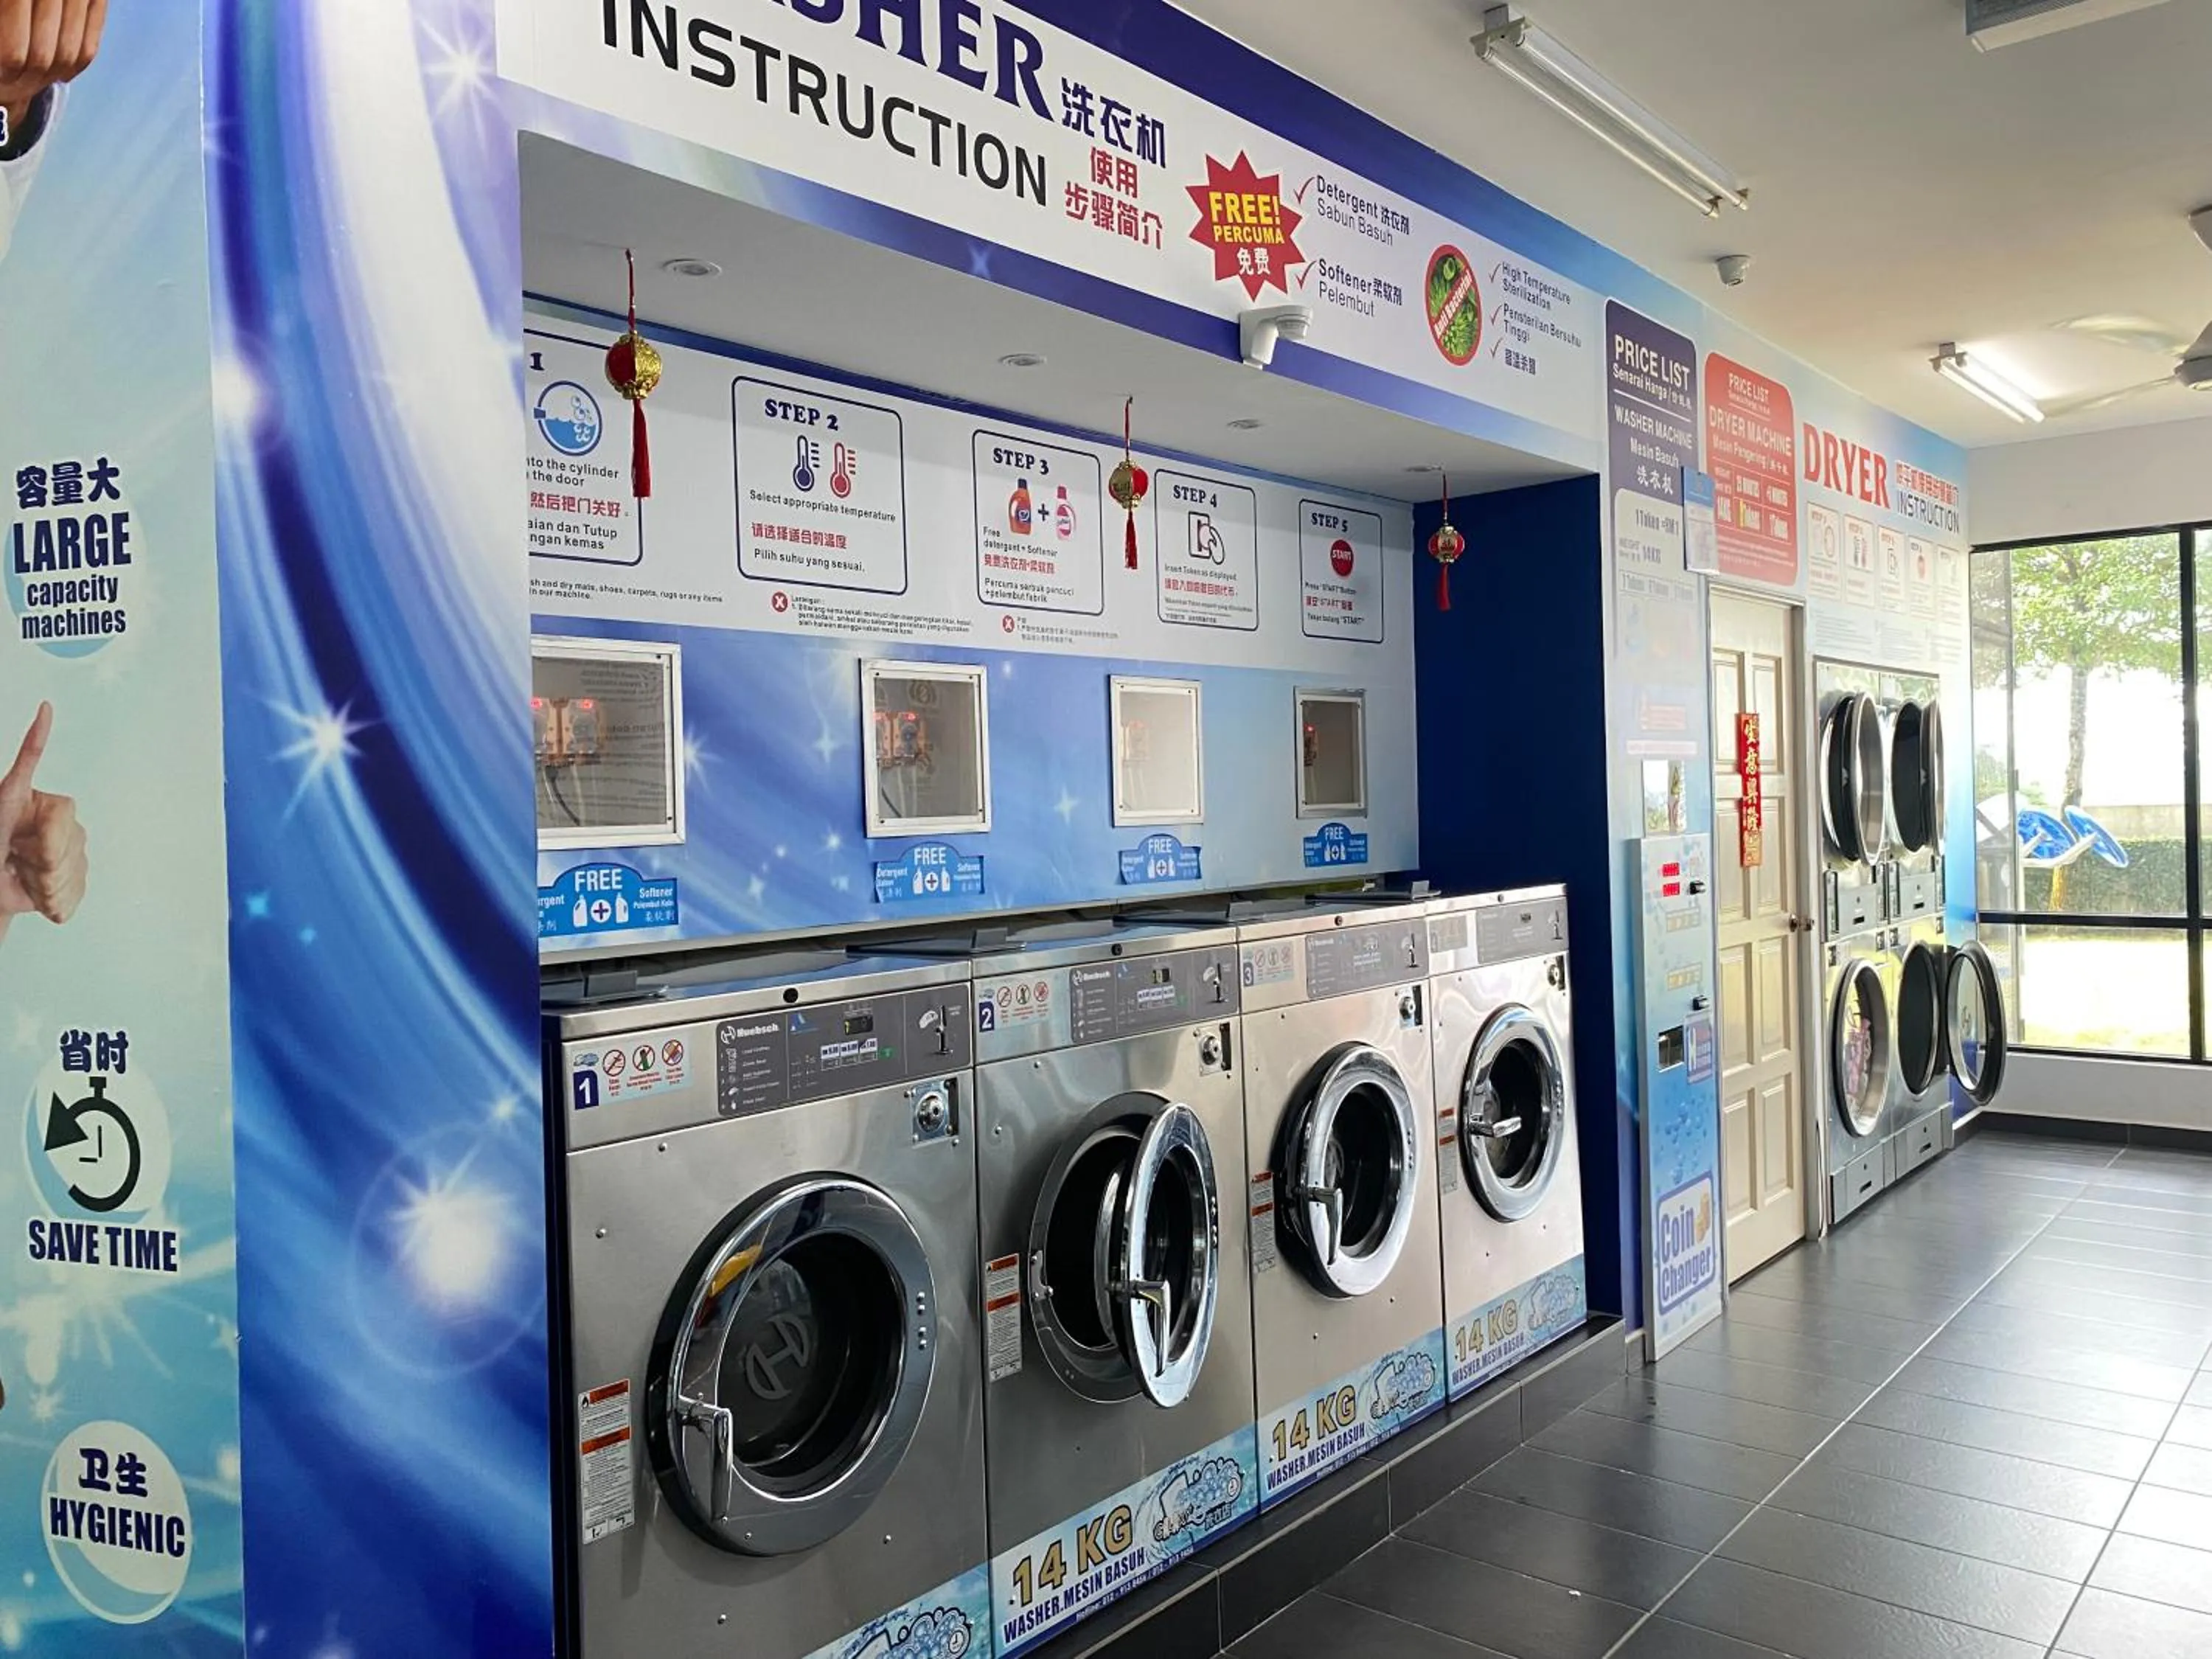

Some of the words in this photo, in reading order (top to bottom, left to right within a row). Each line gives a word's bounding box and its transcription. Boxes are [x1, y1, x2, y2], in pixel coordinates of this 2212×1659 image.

[599, 0, 1046, 206] INSTRUCTION
[1062, 77, 1166, 168] 洗衣机
[1090, 147, 1138, 199] 使用
[1209, 191, 1281, 224] FREE!
[1317, 175, 1378, 218] Detergent
[1065, 180, 1162, 250] 步骤简介
[1318, 198, 1354, 231] Sabun
[1358, 217, 1393, 246] Basuh
[1212, 225, 1284, 245] PERCUMA
[1237, 247, 1270, 276] 免费
[1319, 259, 1372, 293] Softener
[1320, 281, 1374, 317] Pelembut
[1503, 262, 1521, 281] High
[1523, 271, 1571, 305] Temperature
[1504, 319, 1530, 343] Tinggi
[529, 352, 544, 371] 1
[1613, 363, 1644, 389] Senarai
[1614, 334, 1659, 378] PRICE
[1661, 355, 1690, 391] LIST
[1728, 372, 1752, 398] PRICE
[1753, 381, 1770, 403] LIST
[765, 398, 820, 425] STEP
[827, 414, 838, 431] 2
[1614, 403, 1654, 437] WASHER
[1655, 419, 1692, 450] MACHINE
[1708, 406, 1746, 437] DRYER
[1747, 420, 1792, 456] MACHINE
[547, 459, 566, 471] the
[569, 464, 619, 479] cylinder
[993, 448, 1034, 470] STEP
[1039, 459, 1049, 475] 3
[1630, 437, 1654, 460] Mesin
[1655, 446, 1679, 470] Basuh
[1803, 422, 1891, 509] DRYER
[16, 457, 120, 509] 容量大
[533, 470, 552, 482] the
[556, 474, 585, 487] door
[750, 490, 781, 504] Select
[783, 497, 838, 513] appropriate
[841, 504, 896, 523] temperature
[1173, 484, 1206, 504] STEP
[1210, 492, 1218, 508] 4
[1896, 490, 1959, 534] INSTRUCTION
[557, 521, 580, 534] dan
[582, 524, 617, 540] Tutup
[983, 526, 1001, 538] Free
[1311, 512, 1338, 529] STEP
[1341, 520, 1349, 532] 5
[13, 512, 131, 574] LARGE
[565, 535, 605, 549] kemas
[754, 548, 777, 561] Pilih
[780, 552, 804, 563] suhu
[806, 556, 830, 569] yang
[1332, 550, 1352, 561] START
[27, 574, 118, 608] capacity
[542, 580, 558, 588] and
[984, 578, 1018, 591] Percuma
[22, 608, 126, 639] machines
[1148, 838, 1172, 854] FREE
[1325, 827, 1344, 841] FREE
[914, 847, 946, 866] FREE
[574, 869, 622, 892] FREE
[639, 888, 672, 898] Softener
[1244, 966, 1253, 984] 3
[981, 1009, 992, 1029] 2
[60, 1029, 128, 1074] 省时
[579, 1077, 591, 1105] 1
[29, 1220, 100, 1264] SAVE
[105, 1227, 178, 1272] TIME
[1660, 1204, 1694, 1261] Coin
[1661, 1251, 1711, 1301] Changer
[1455, 1325, 1484, 1362] 14
[1488, 1299, 1518, 1346] KG
[1503, 1335, 1525, 1360] BASUH
[1272, 1408, 1310, 1462] 14
[1316, 1384, 1357, 1441] KG
[1338, 1423, 1366, 1450] BASUH
[78, 1447, 148, 1498] 卫生
[49, 1497, 185, 1558] HYGIENIC
[1012, 1539, 1067, 1607] 14
[1077, 1504, 1133, 1575] KG
[1105, 1547, 1146, 1586] BASUH
